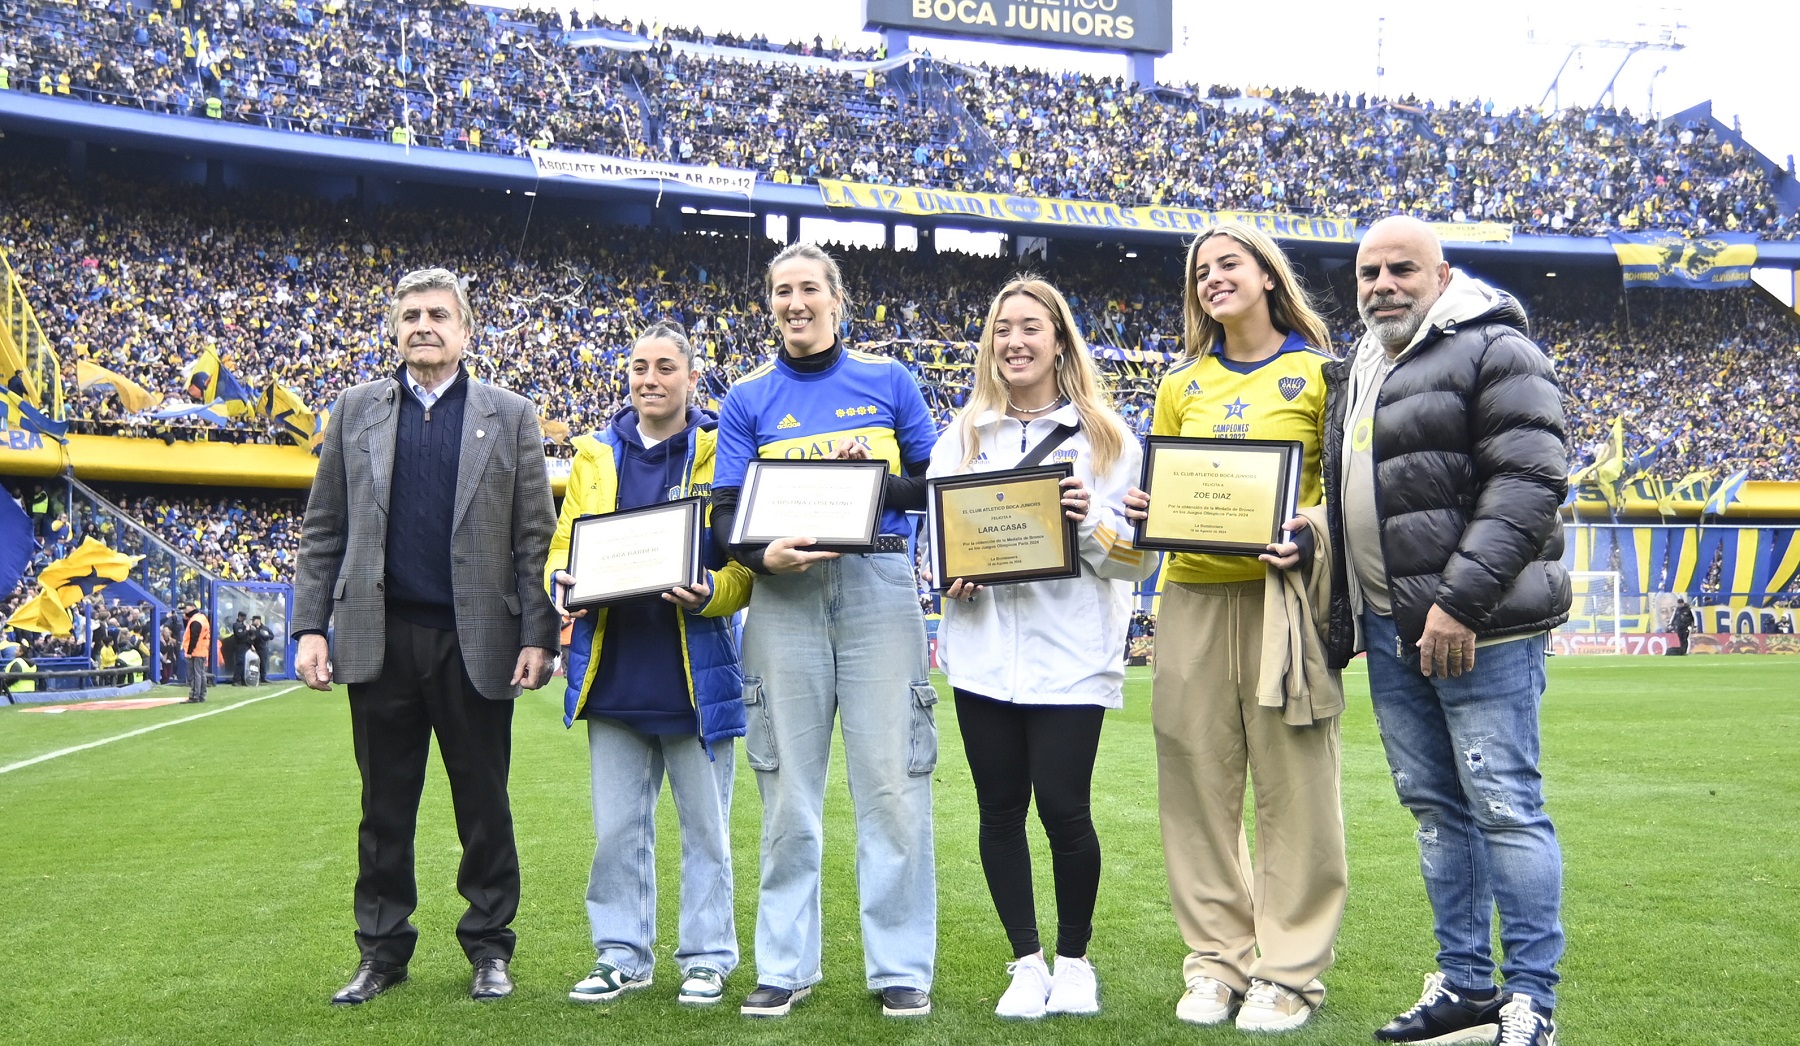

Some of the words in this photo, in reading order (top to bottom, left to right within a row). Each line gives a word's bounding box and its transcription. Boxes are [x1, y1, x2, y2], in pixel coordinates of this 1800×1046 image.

[912, 0, 997, 26] BOCA
[1005, 5, 1135, 39] JUNIORS
[819, 182, 863, 208] LA
[869, 188, 907, 211] 12
[914, 191, 1007, 218] UNIDA
[1048, 203, 1140, 227] JAMAS
[1230, 404, 1241, 414] 73
[776, 421, 801, 430] adidas
[1212, 423, 1250, 433] CAMPEONES
[1194, 491, 1210, 499] ZOE
[1212, 492, 1232, 500] DIAZ
[978, 525, 999, 534] LARA
[1000, 522, 1027, 531] CASAS
